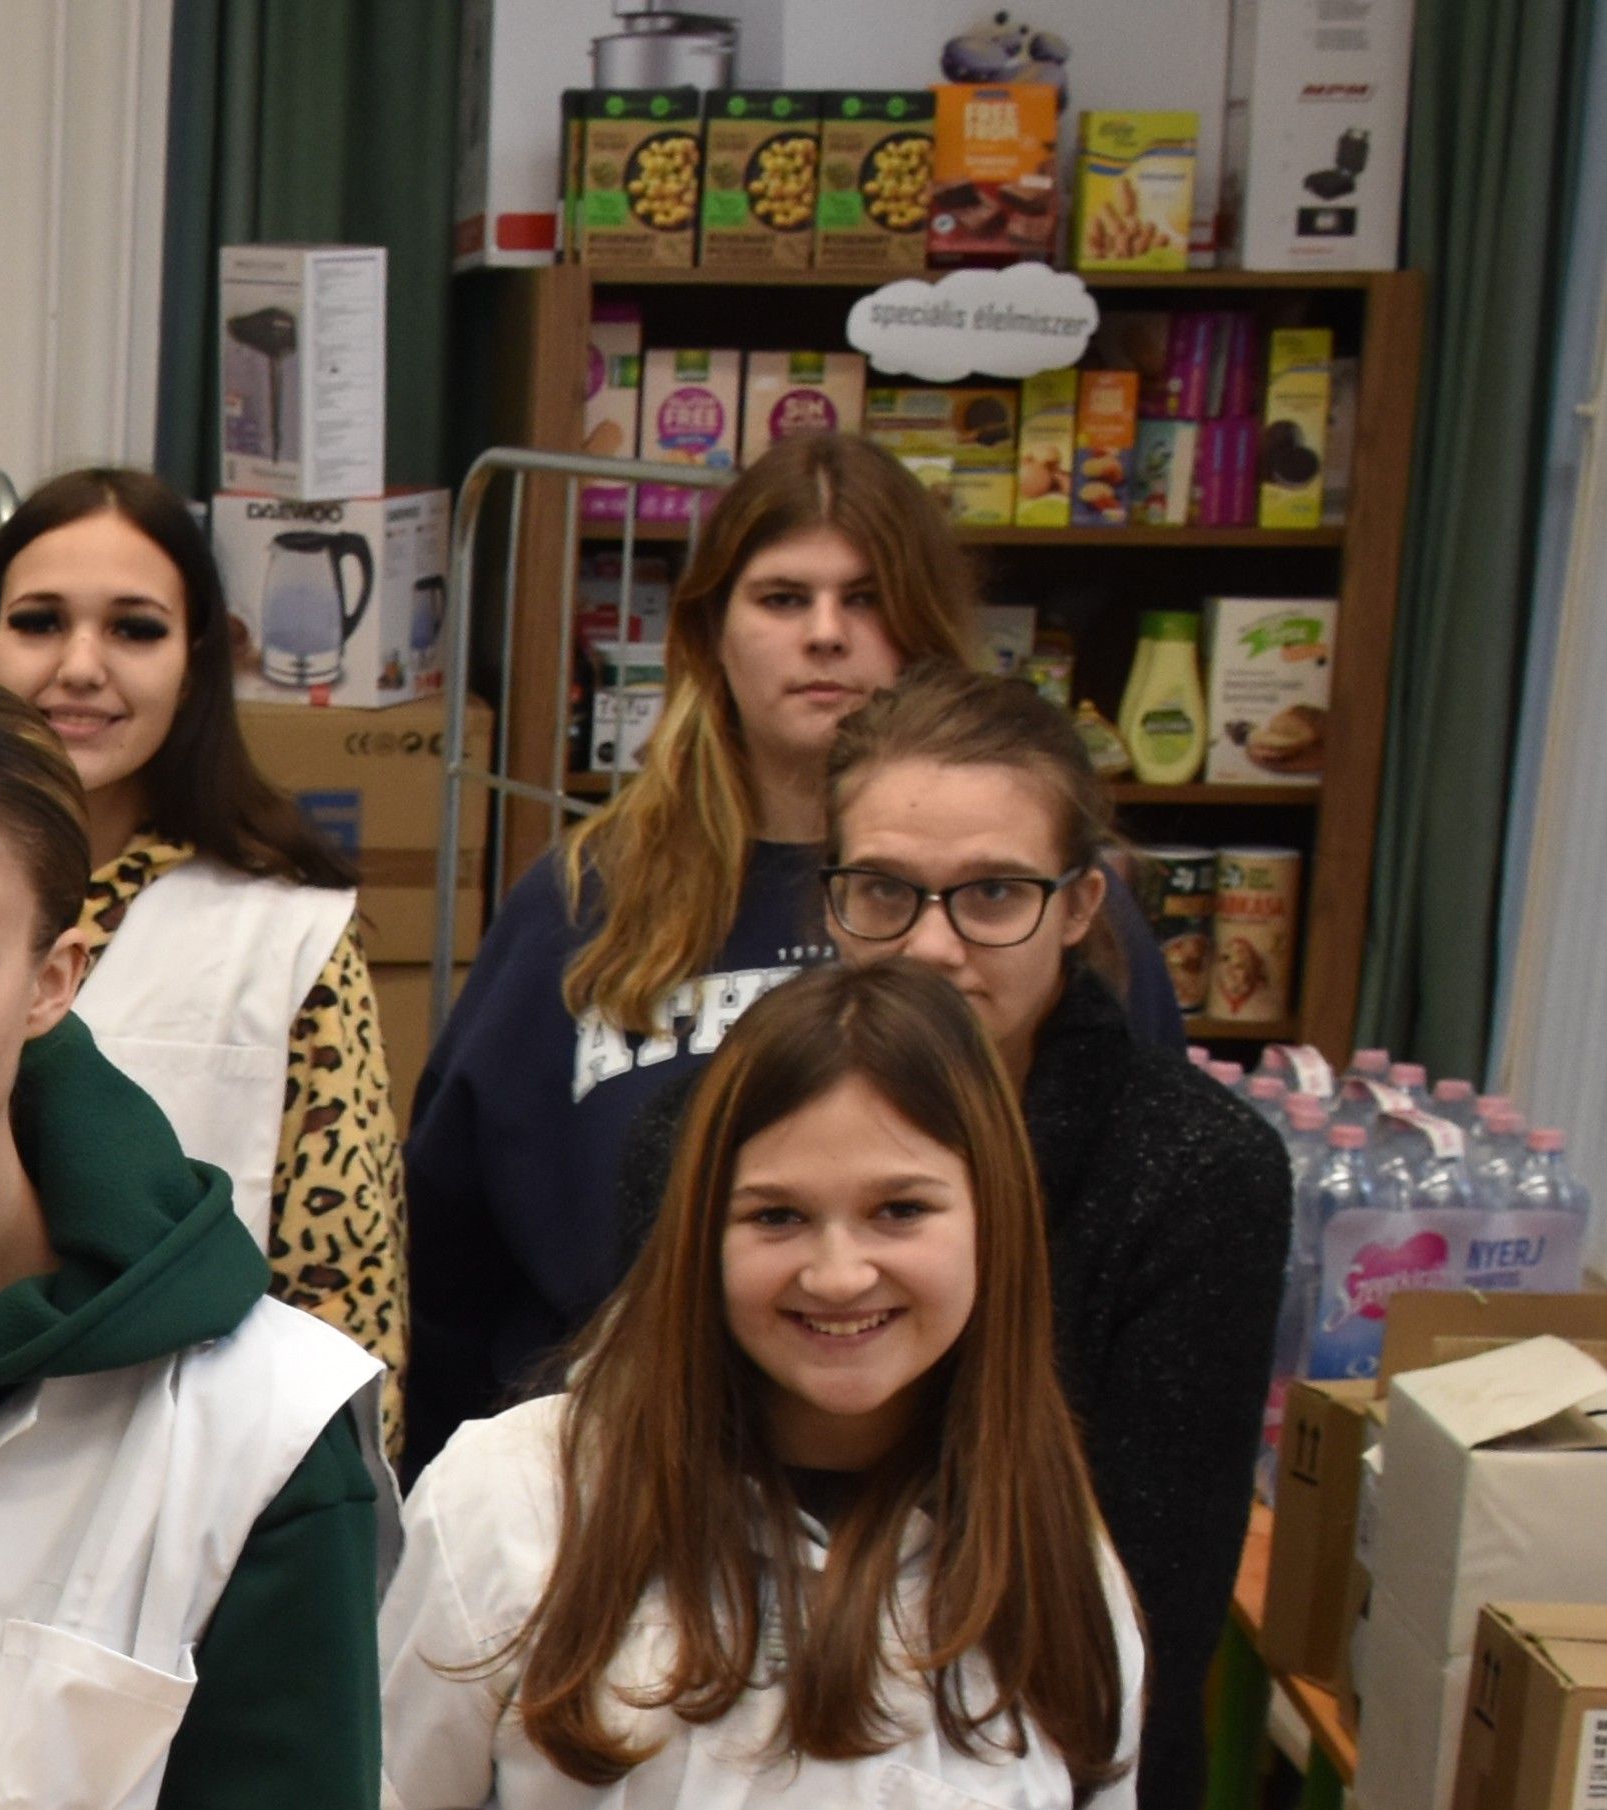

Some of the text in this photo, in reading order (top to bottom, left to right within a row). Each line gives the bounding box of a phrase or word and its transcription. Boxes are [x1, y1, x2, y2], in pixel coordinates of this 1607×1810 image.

[871, 299, 1088, 336] speciális élelmiszer
[246, 502, 344, 523] DAEWOO
[1466, 1236, 1547, 1269] NYERJ
